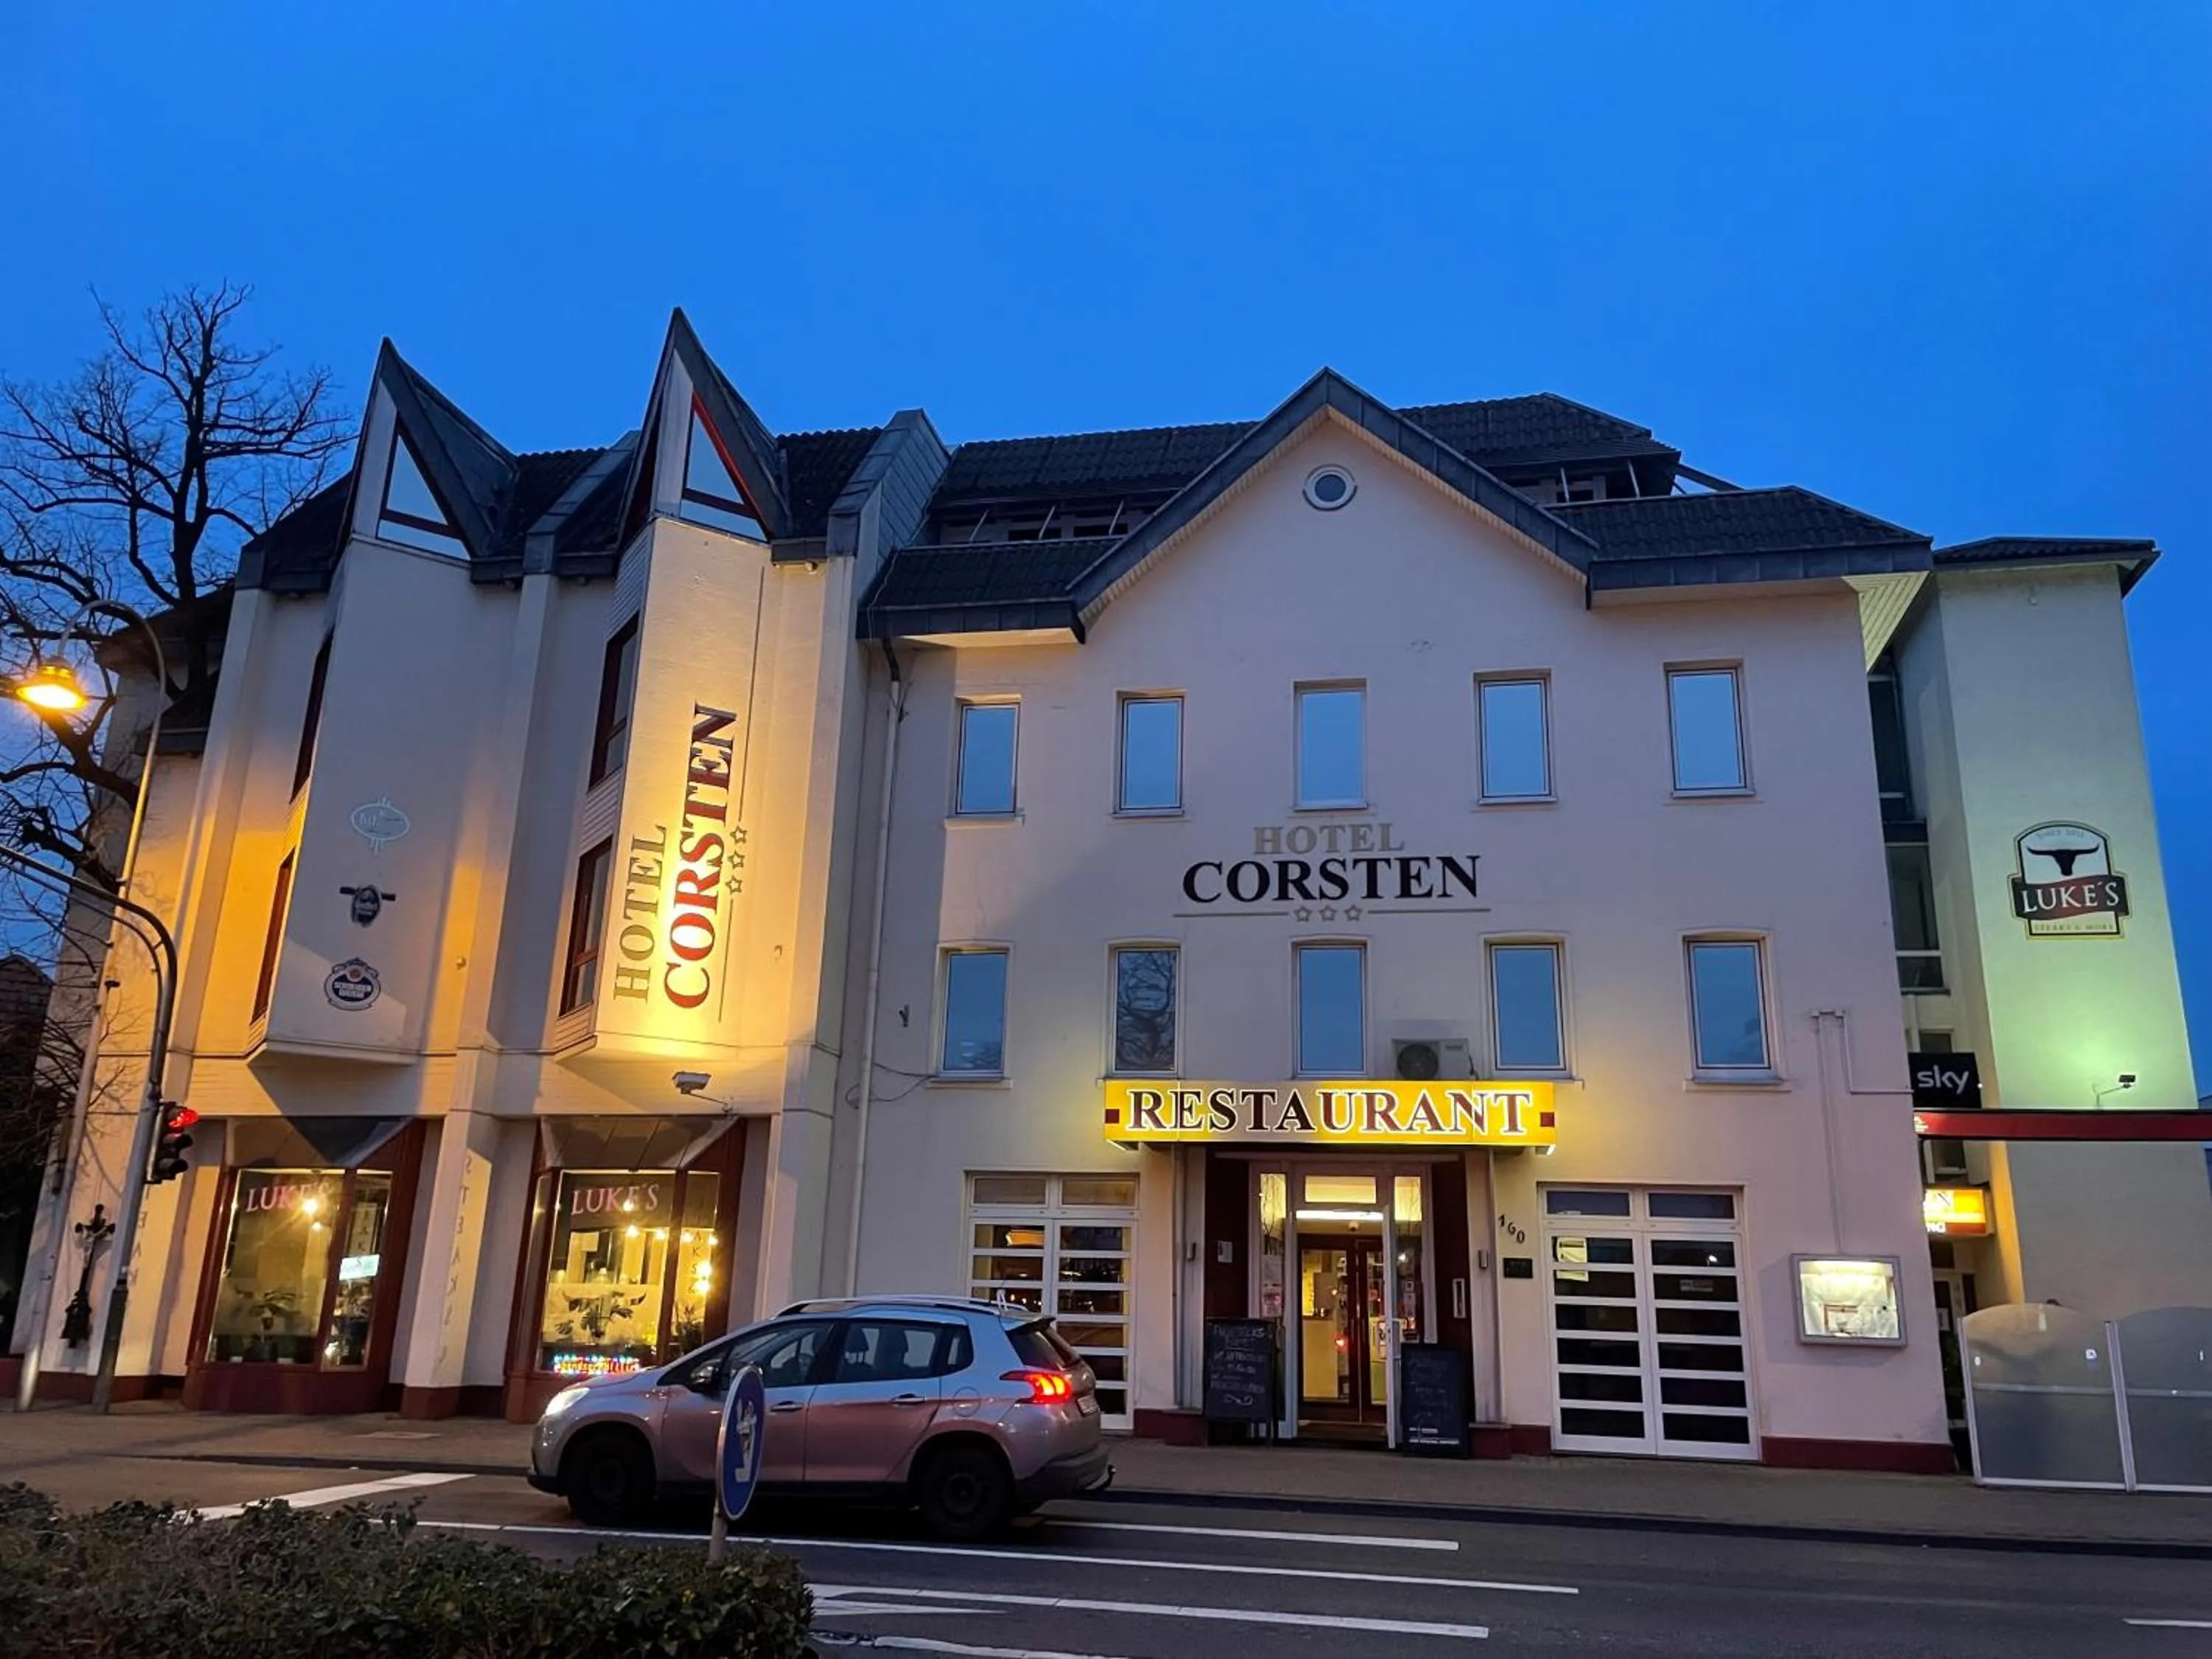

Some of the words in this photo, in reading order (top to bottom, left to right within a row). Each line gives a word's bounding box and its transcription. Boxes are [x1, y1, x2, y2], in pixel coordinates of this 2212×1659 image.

[664, 699, 737, 1009] CORSTEN
[1254, 822, 1405, 855] HOTEL
[1182, 855, 1481, 903] CORSTEN
[613, 824, 667, 1004] HOTEL
[1918, 1065, 1969, 1095] sky
[1125, 1088, 1531, 1134] RESTAURANT
[1498, 1214, 1526, 1245] 160
